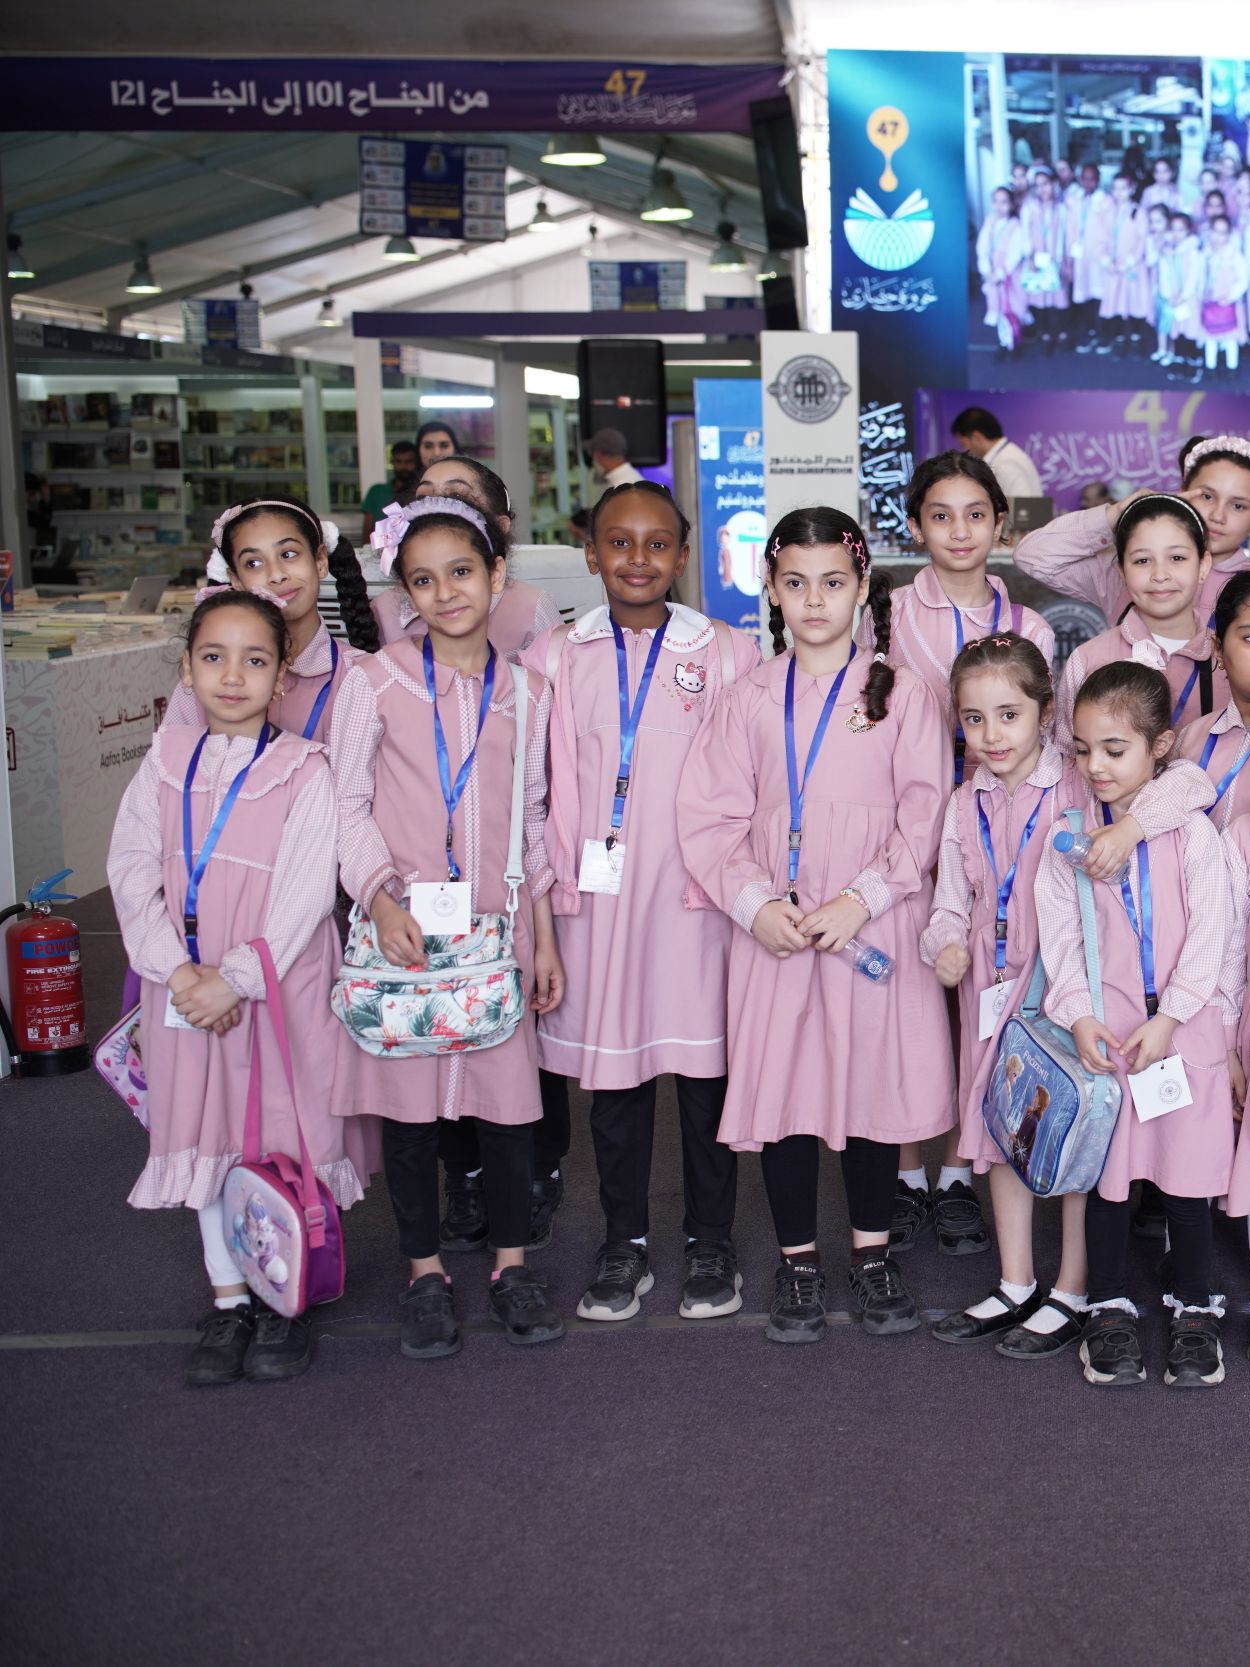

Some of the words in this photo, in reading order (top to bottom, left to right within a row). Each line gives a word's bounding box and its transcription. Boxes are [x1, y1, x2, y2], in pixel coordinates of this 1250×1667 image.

[150, 80, 257, 115] الجناح
[261, 81, 300, 116] إلى
[604, 69, 647, 97] 47
[348, 81, 445, 117] الجناح
[449, 87, 489, 114] من
[876, 120, 900, 138] 47
